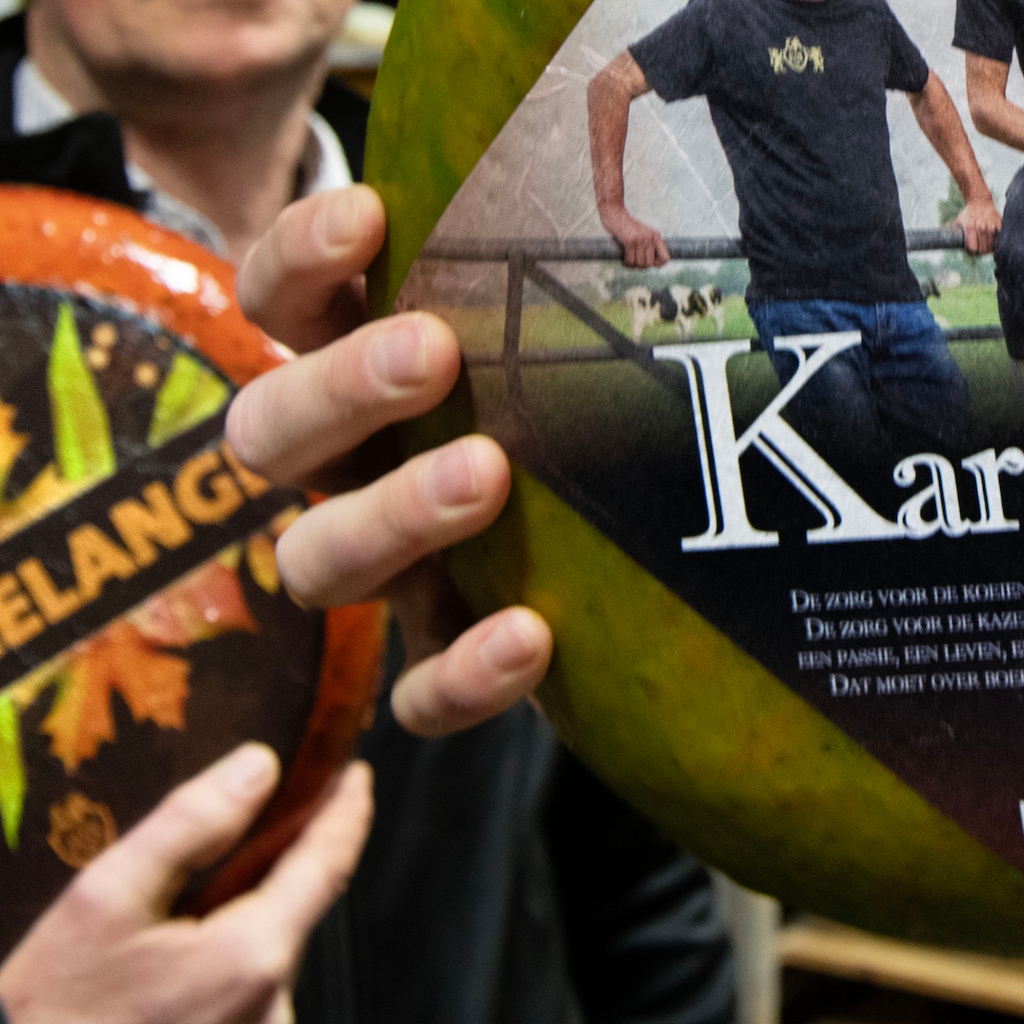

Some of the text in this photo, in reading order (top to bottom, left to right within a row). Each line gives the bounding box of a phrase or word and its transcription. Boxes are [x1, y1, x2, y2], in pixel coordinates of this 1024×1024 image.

[824, 590, 873, 611] ZORG
[877, 587, 928, 607] VOOR
[933, 585, 959, 604] DE
[840, 618, 888, 639] ZORG
[893, 615, 943, 635] VOOR
[948, 613, 973, 633] DE
[798, 650, 832, 670] EEN
[837, 647, 900, 669] PASSIE,
[904, 644, 938, 665] EEN
[944, 640, 1007, 664] LEVEN,
[876, 674, 926, 695] MOET
[931, 671, 980, 692] OVER
